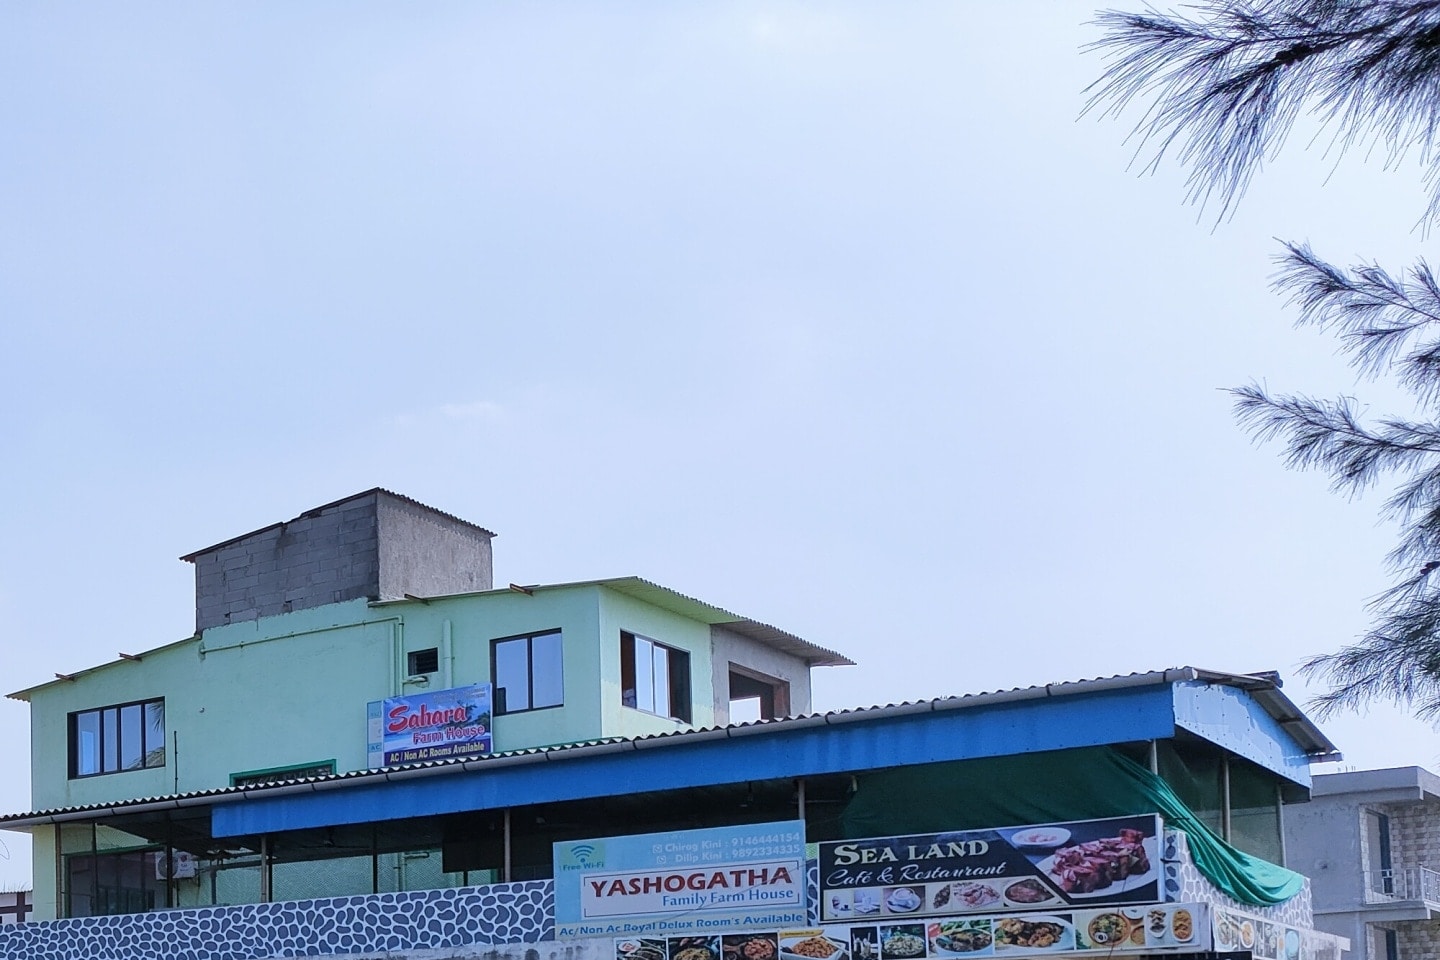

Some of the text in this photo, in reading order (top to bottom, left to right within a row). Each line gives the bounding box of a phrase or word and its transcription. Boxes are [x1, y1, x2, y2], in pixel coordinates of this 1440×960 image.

[388, 703, 467, 732] Sahara
[413, 725, 485, 745] Farm House
[390, 752, 399, 762] AC
[404, 750, 417, 760] Non
[419, 748, 428, 758] AC
[429, 746, 452, 757] Rooms
[452, 742, 485, 754] Available
[591, 866, 793, 898] YASHOGATHA
[826, 861, 1007, 887] Café & Restaurant
[662, 887, 794, 907] Family Farm House
[560, 912, 803, 936] Ac/Non Ac Royal Delux Room's Available
